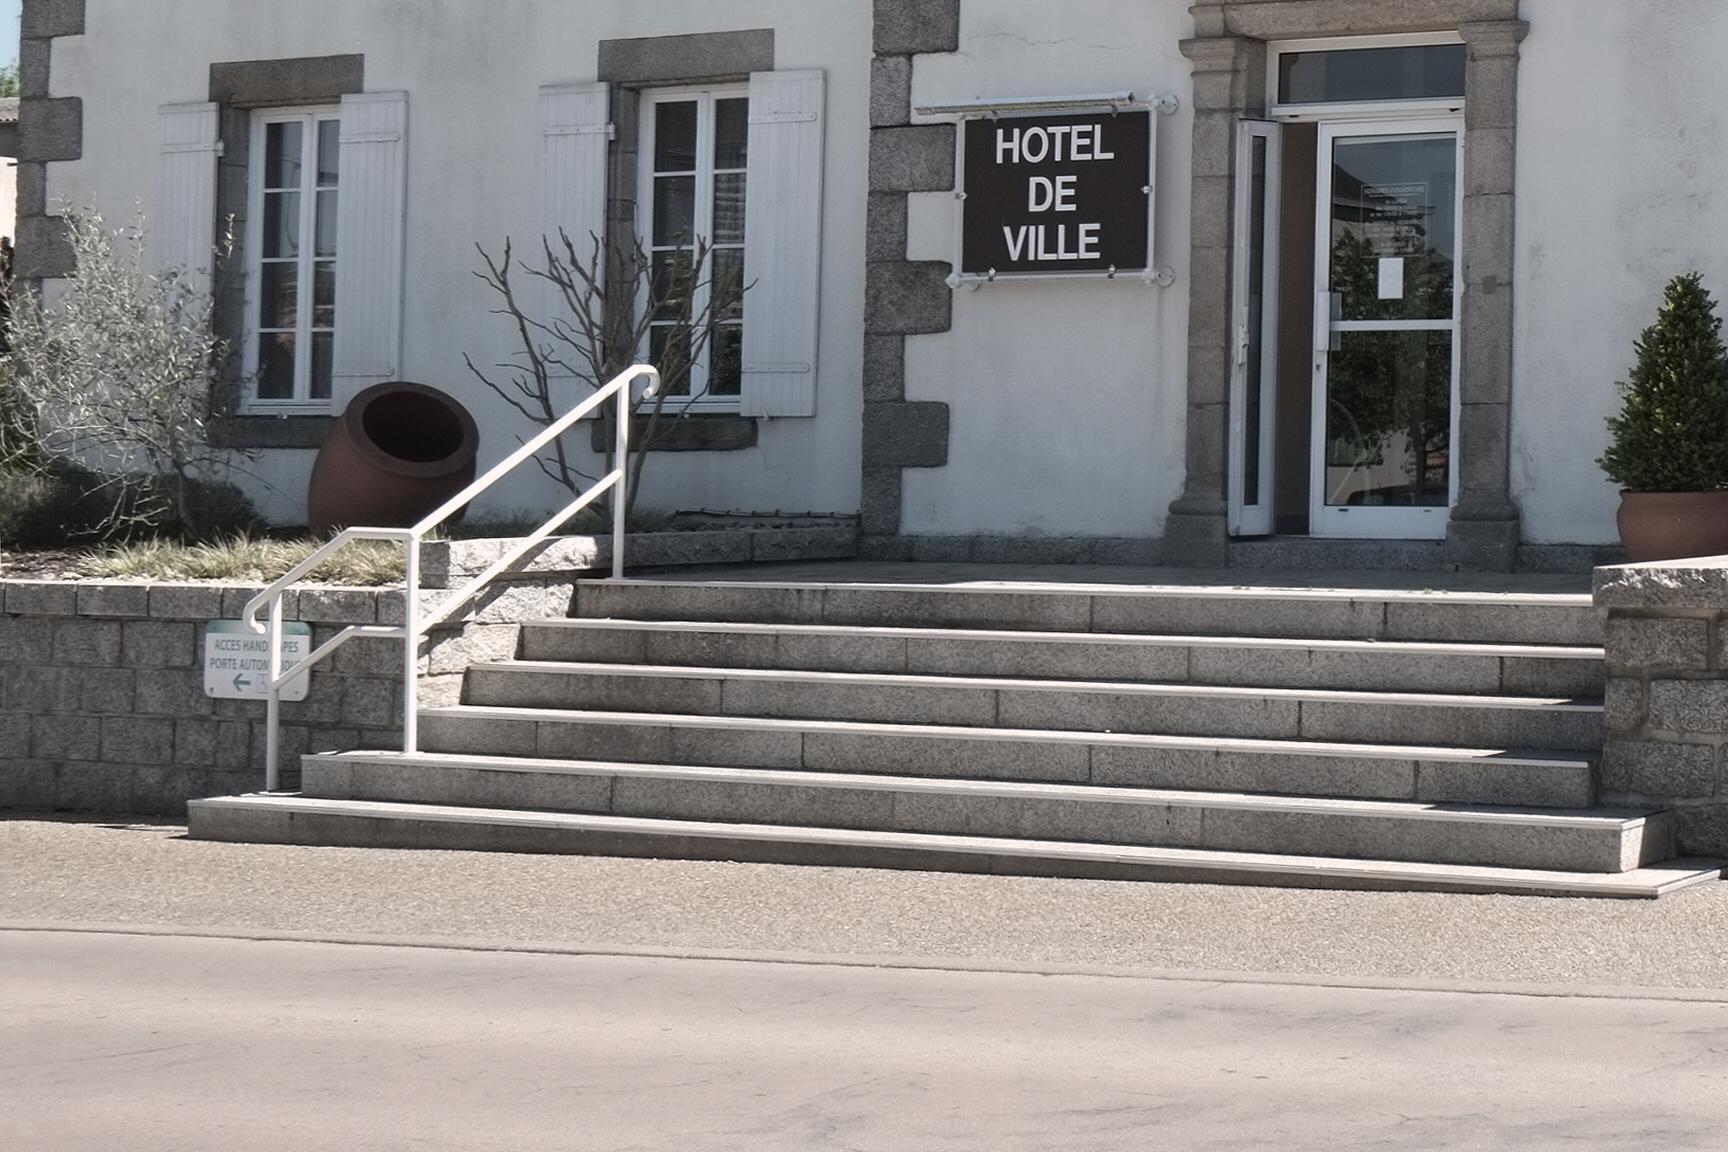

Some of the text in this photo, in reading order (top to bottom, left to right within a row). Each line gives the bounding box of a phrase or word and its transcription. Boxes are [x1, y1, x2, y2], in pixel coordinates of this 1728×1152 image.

[996, 124, 1115, 164] HOTEL
[1028, 175, 1077, 212] DE
[1003, 223, 1101, 262] VILLE
[210, 658, 236, 669] PORTE
[214, 639, 298, 653] ACCES HANDPES
